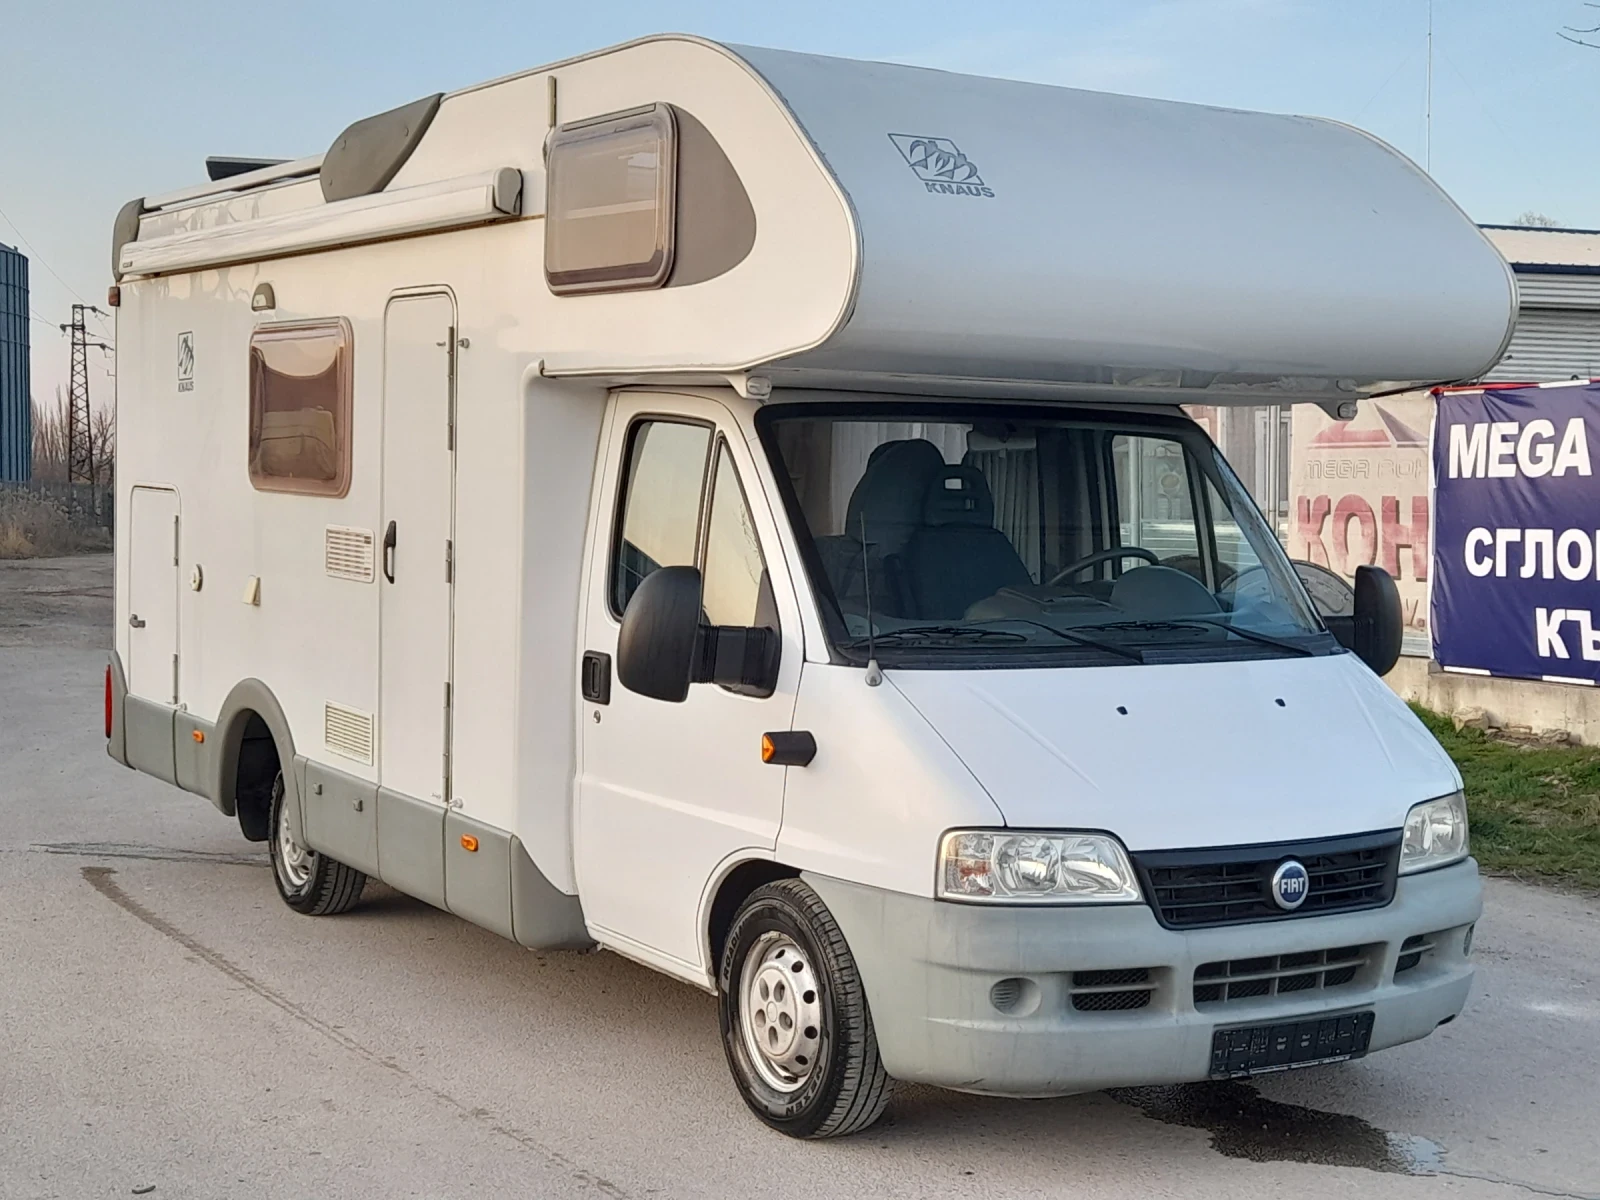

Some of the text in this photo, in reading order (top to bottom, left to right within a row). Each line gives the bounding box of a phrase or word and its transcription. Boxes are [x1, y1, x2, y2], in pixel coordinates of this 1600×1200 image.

[925, 182, 995, 198] KNAUS
[1448, 417, 1593, 479] MEGA
[1305, 459, 1370, 479] MEGA
[1281, 877, 1305, 894] FIAT
[785, 1064, 823, 1116] NEXEN
